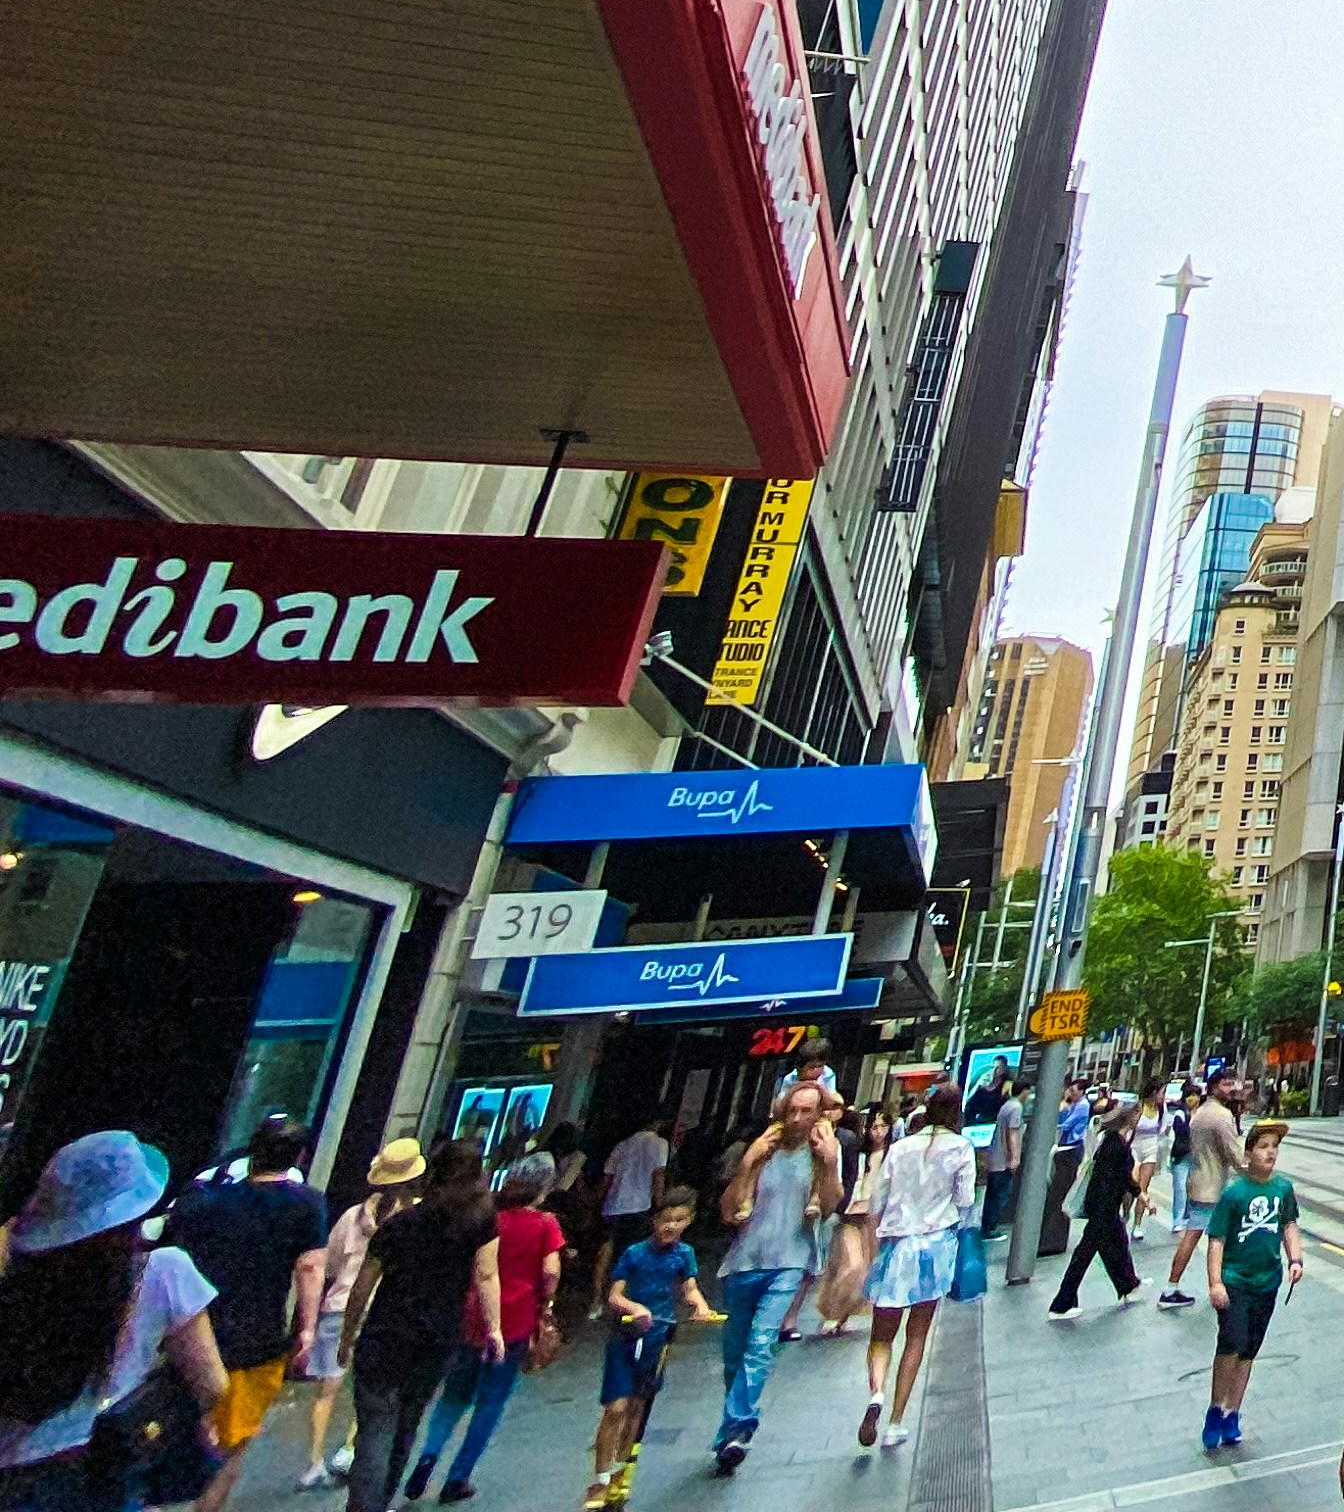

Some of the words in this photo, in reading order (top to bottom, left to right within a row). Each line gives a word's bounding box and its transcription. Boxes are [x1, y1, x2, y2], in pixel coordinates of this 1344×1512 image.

[738, 512, 785, 612] MURRAY
[667, 787, 735, 810] Bupa
[497, 903, 573, 942] 319
[639, 961, 704, 983] Bupa
[1050, 998, 1083, 1014] END
[1050, 1014, 1081, 1031] TSR
